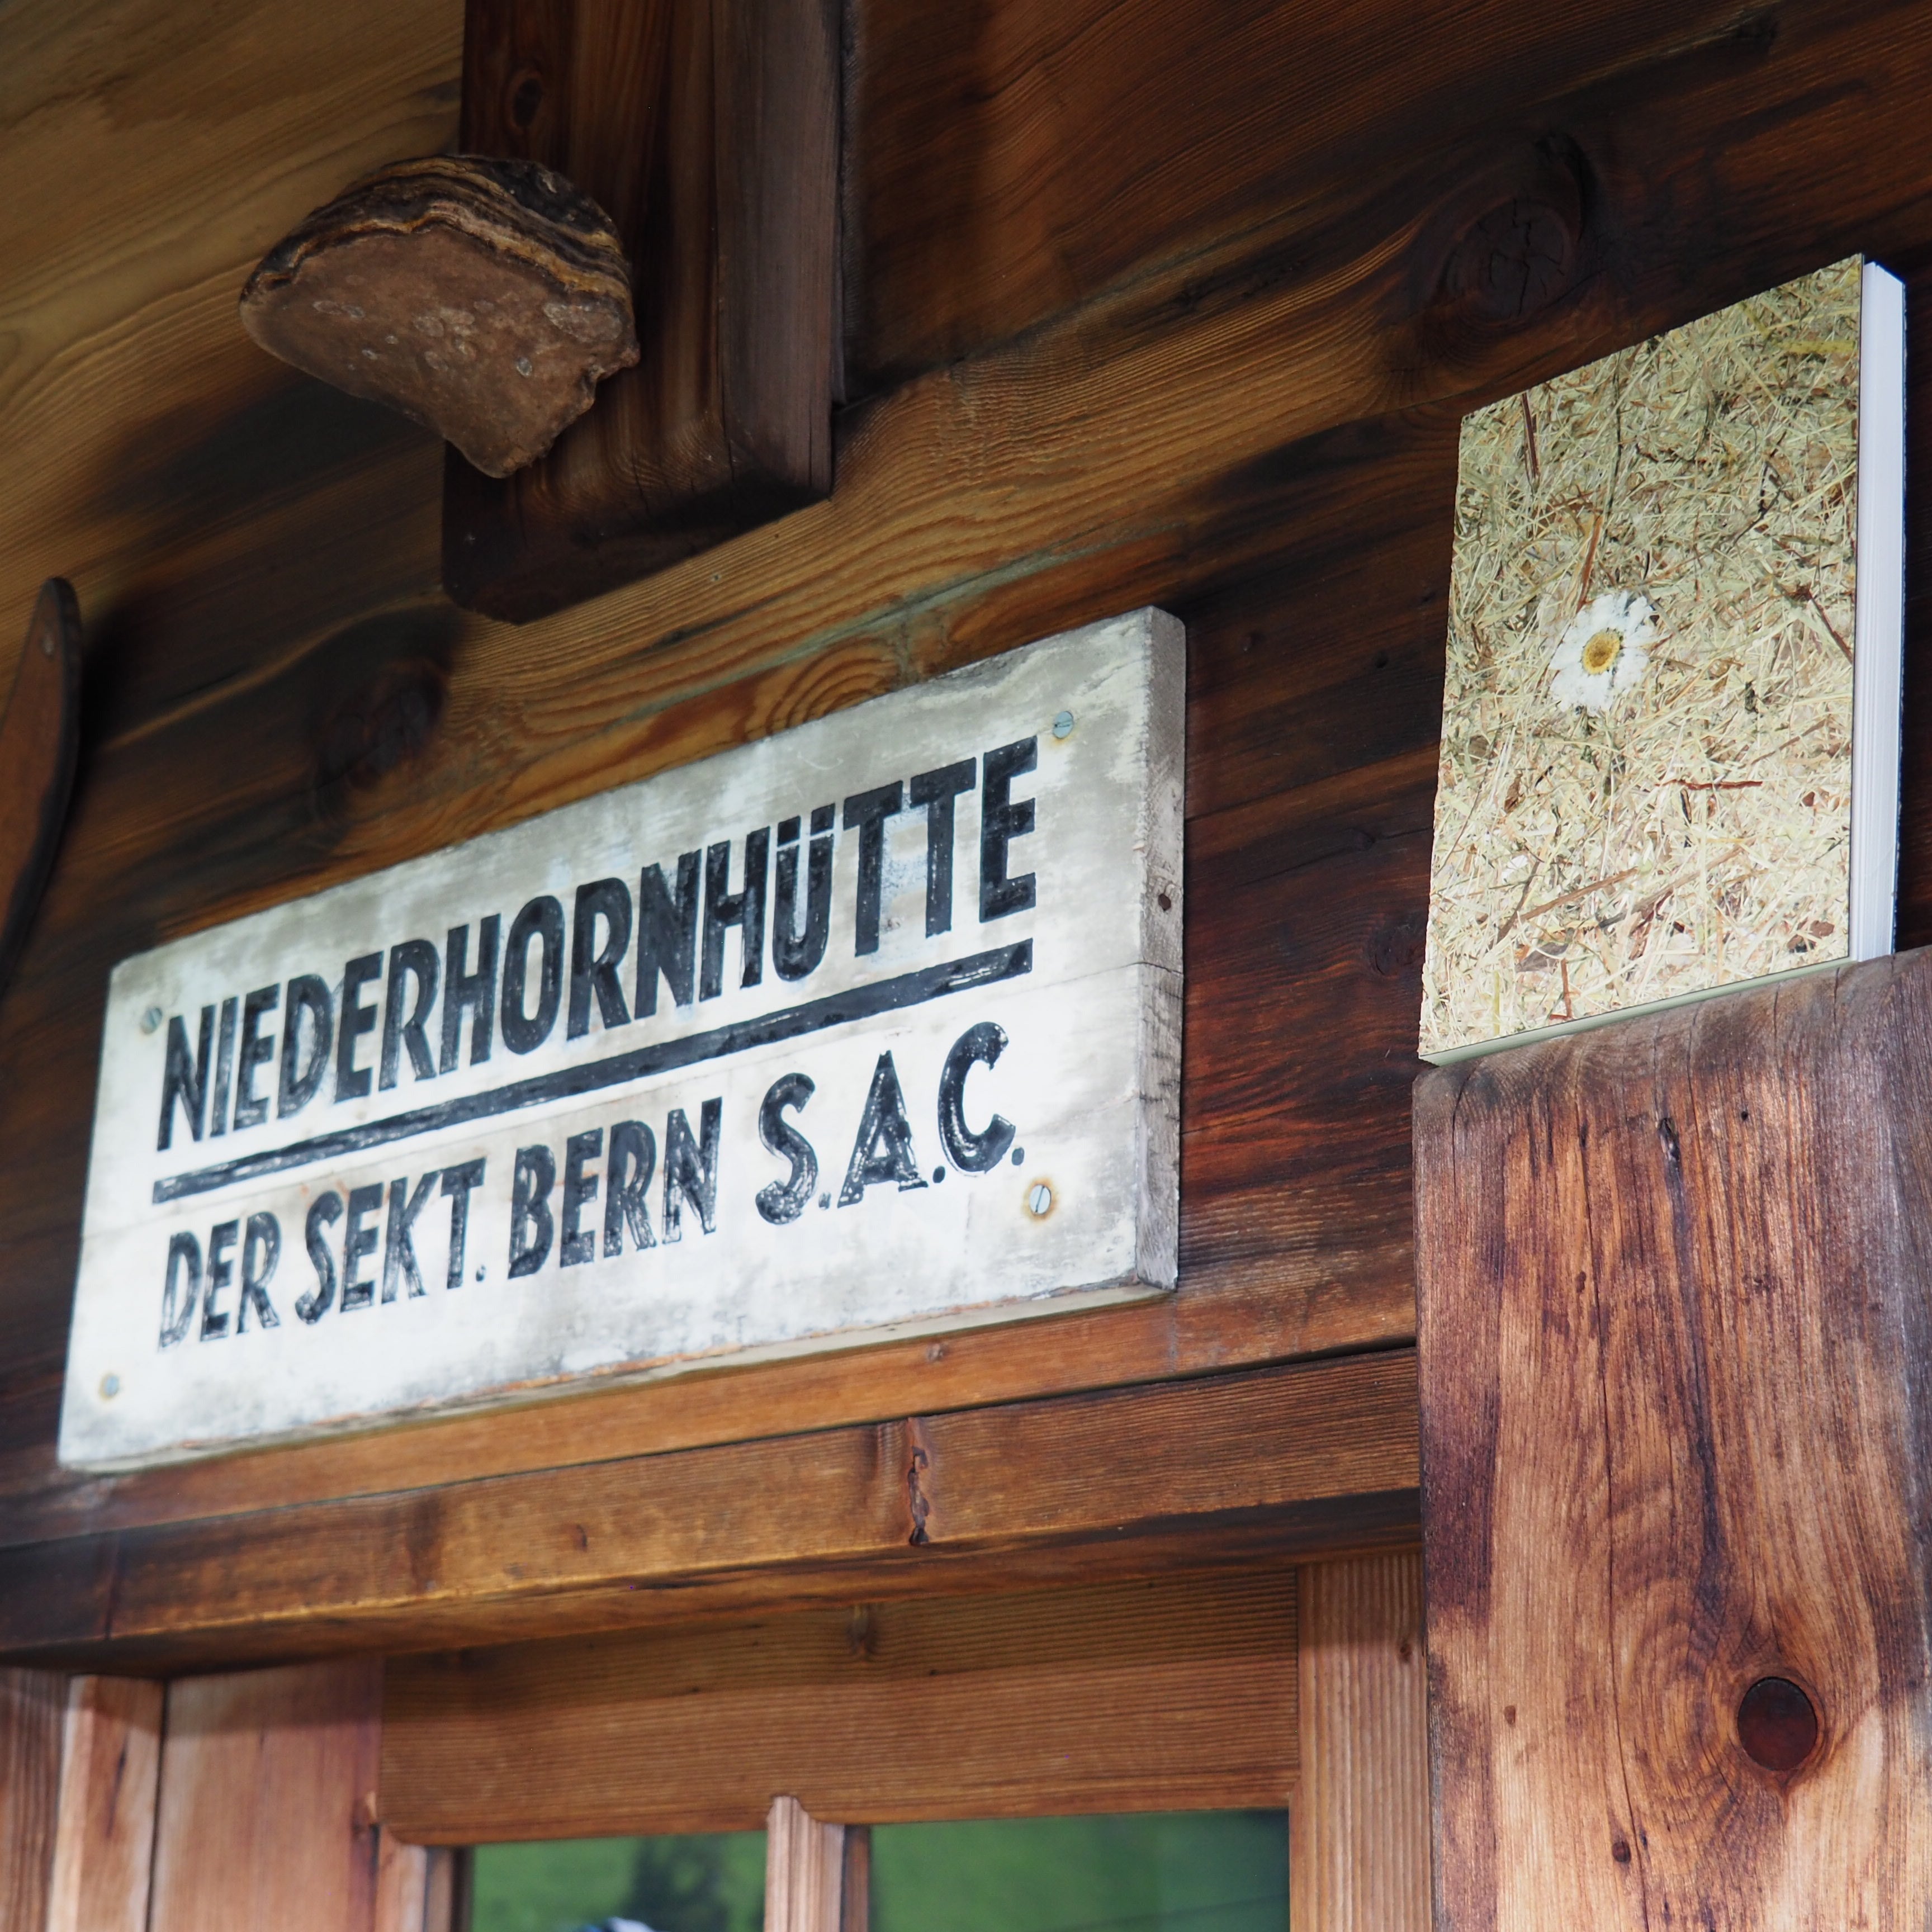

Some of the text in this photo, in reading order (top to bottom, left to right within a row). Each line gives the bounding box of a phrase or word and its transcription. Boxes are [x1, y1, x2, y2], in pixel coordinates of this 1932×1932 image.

[157, 735, 1038, 1152] NIEDERHORNHÜTTE
[158, 1211, 279, 1352] DER
[294, 1157, 486, 1325] SEKT.
[507, 1096, 723, 1280] BERN
